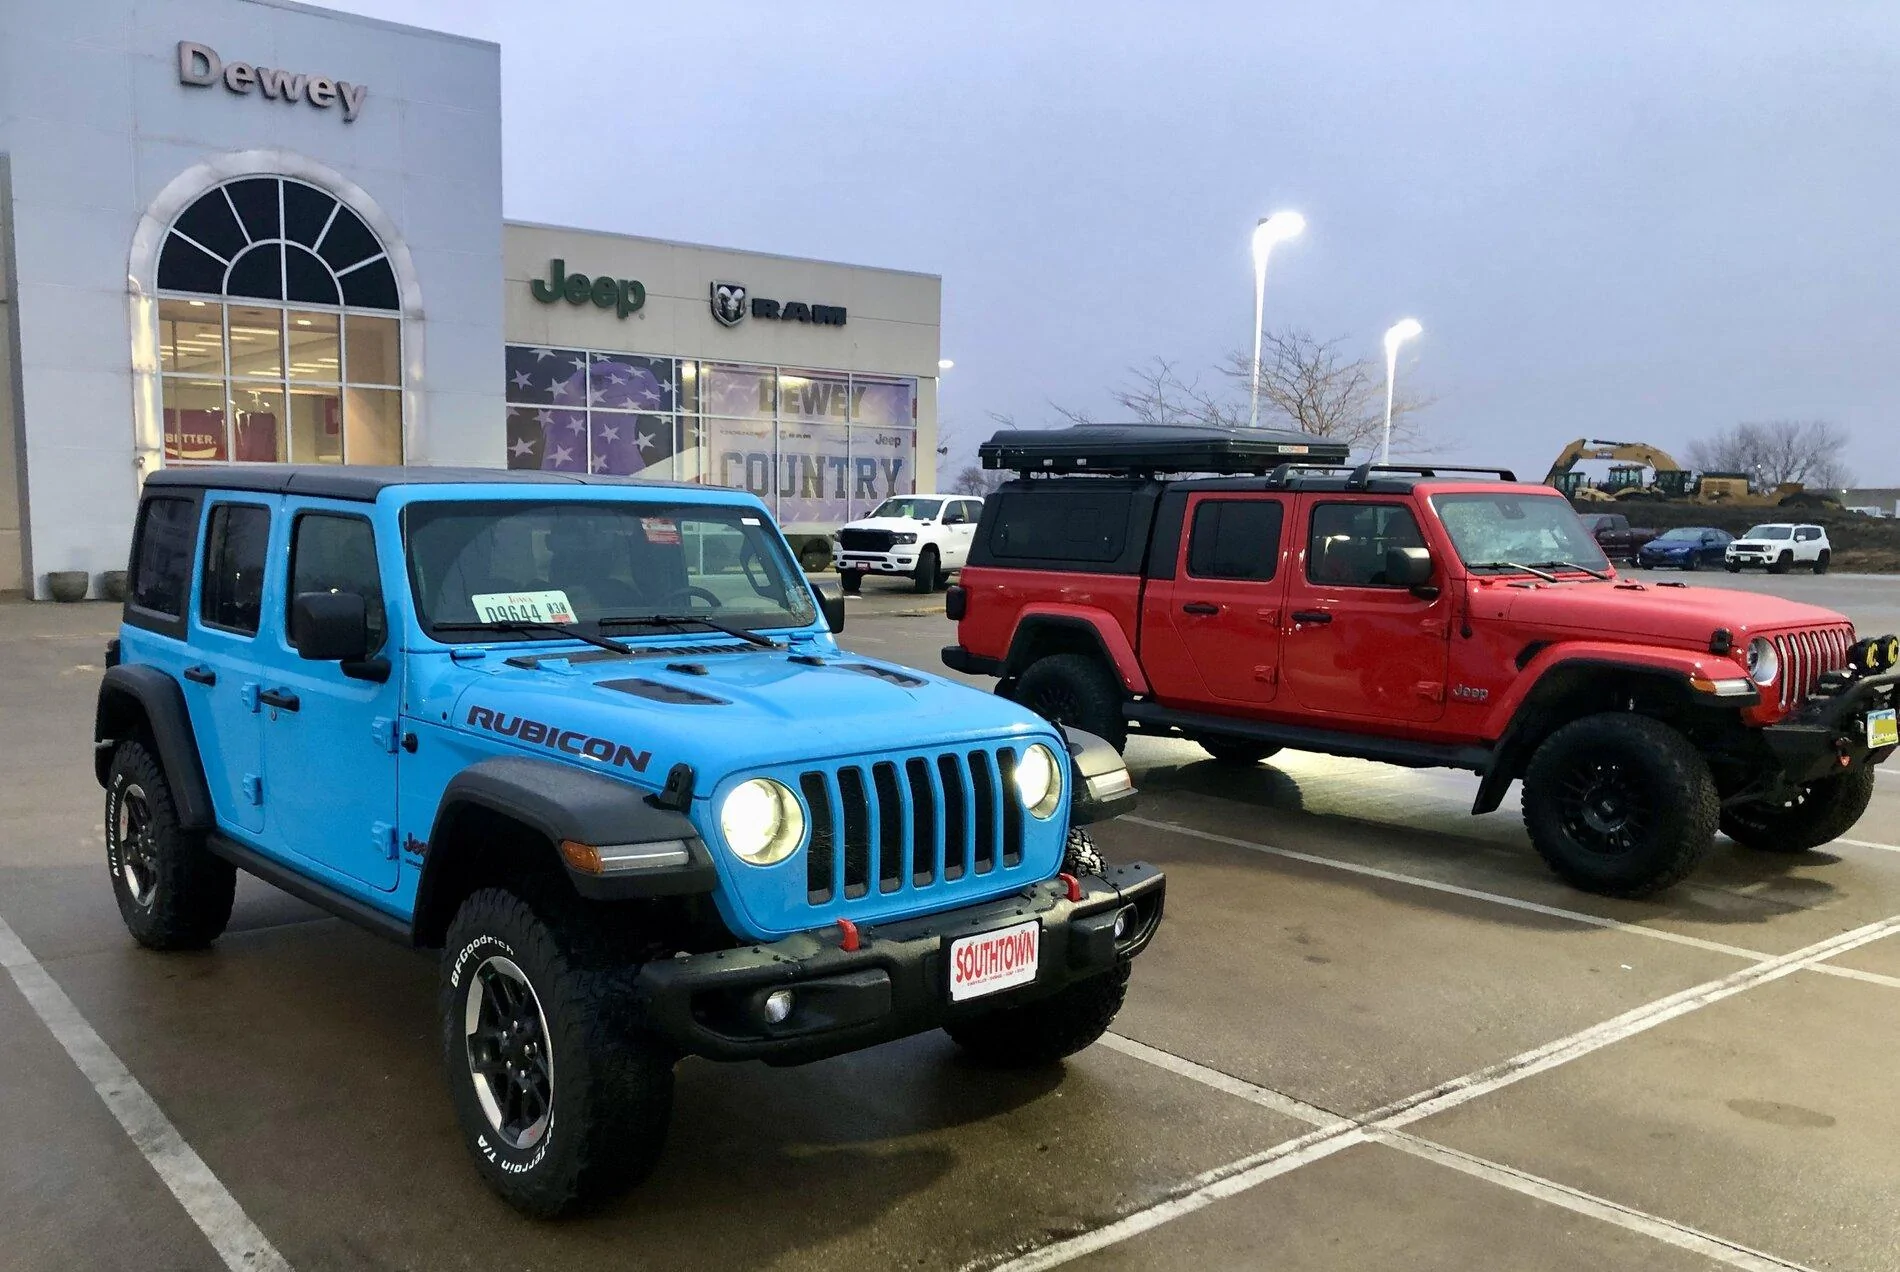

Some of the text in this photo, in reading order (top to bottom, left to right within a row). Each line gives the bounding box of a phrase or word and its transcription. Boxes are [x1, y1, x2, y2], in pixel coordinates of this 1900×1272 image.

[178, 40, 368, 123] Dewey
[530, 258, 646, 320] Jeep
[752, 298, 847, 325] RAM
[759, 378, 867, 418] DEWEY
[875, 433, 902, 448] Jeep
[720, 451, 904, 500] COUNTRY
[1453, 683, 1489, 701] Jeep
[466, 705, 652, 773] RUBICON
[451, 934, 514, 987] BFGoodrich
[956, 930, 1035, 983] SOUTHTOWN
